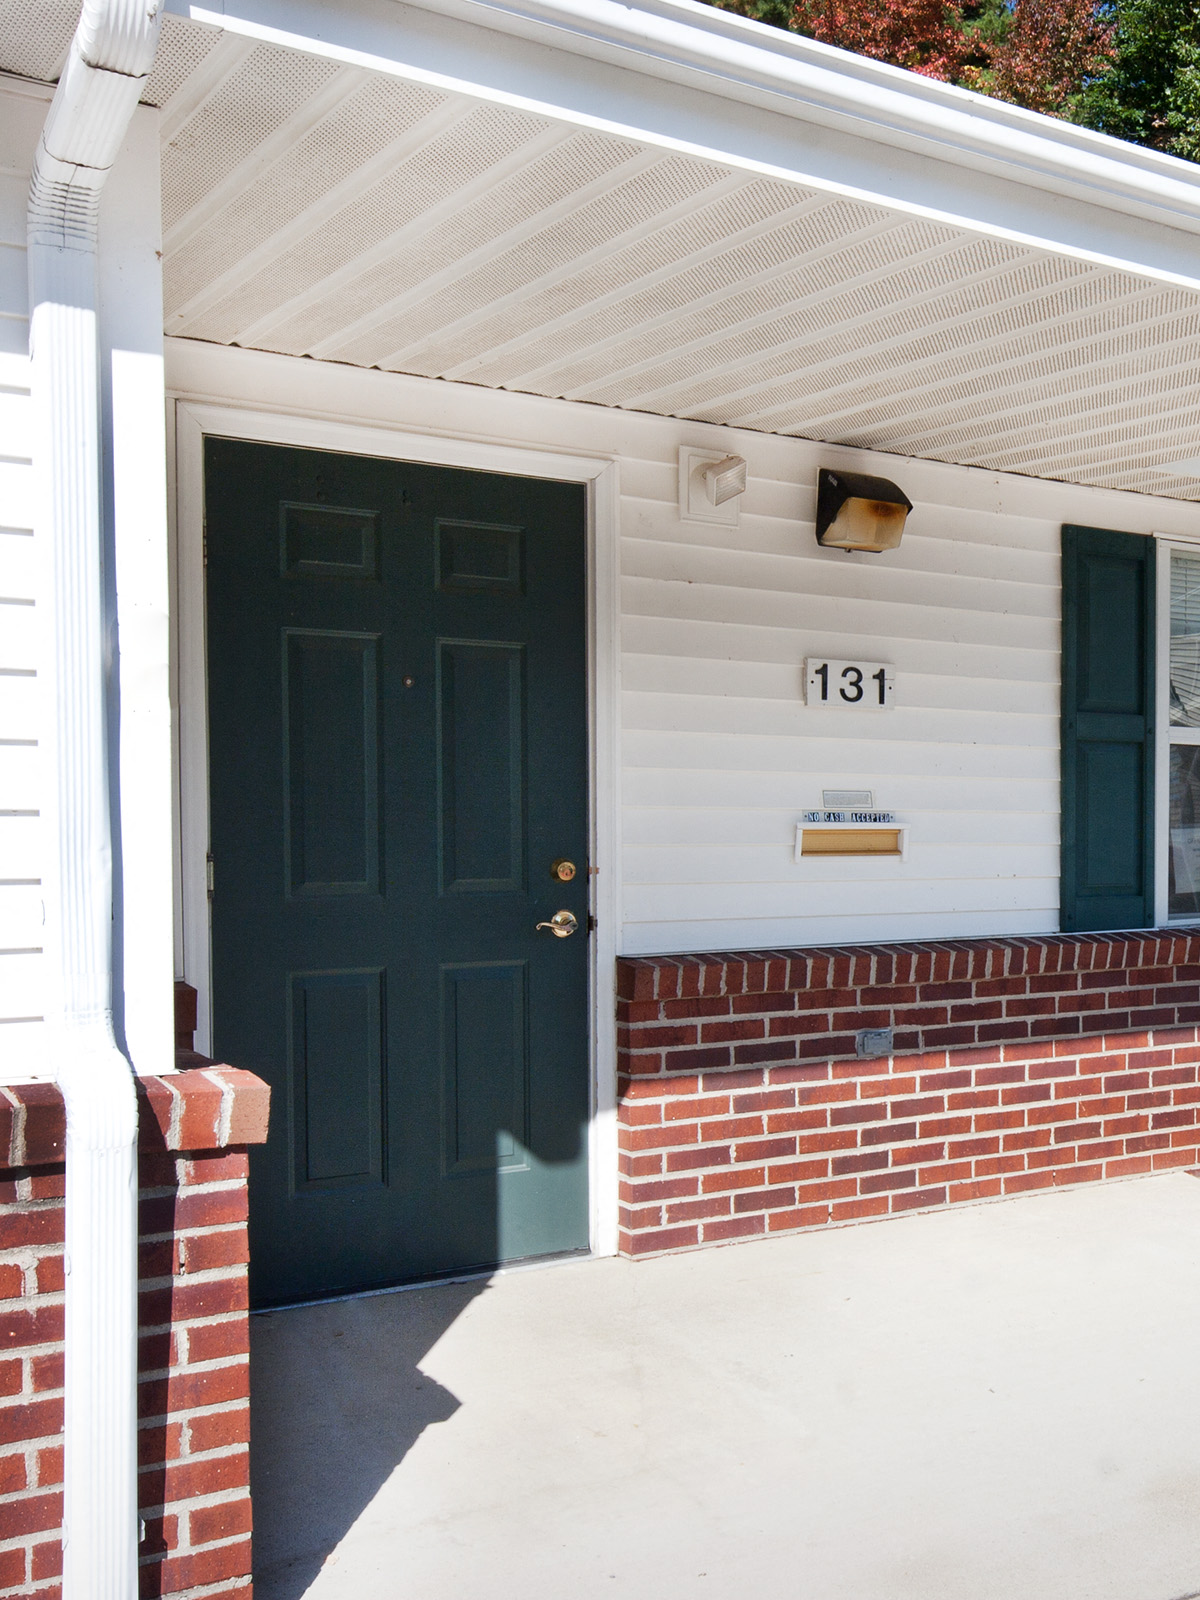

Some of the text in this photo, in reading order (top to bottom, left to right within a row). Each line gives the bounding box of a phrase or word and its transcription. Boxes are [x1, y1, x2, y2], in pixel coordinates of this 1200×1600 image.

[815, 663, 885, 705] 131
[808, 812, 890, 823] NO CASH ACCEPTED
